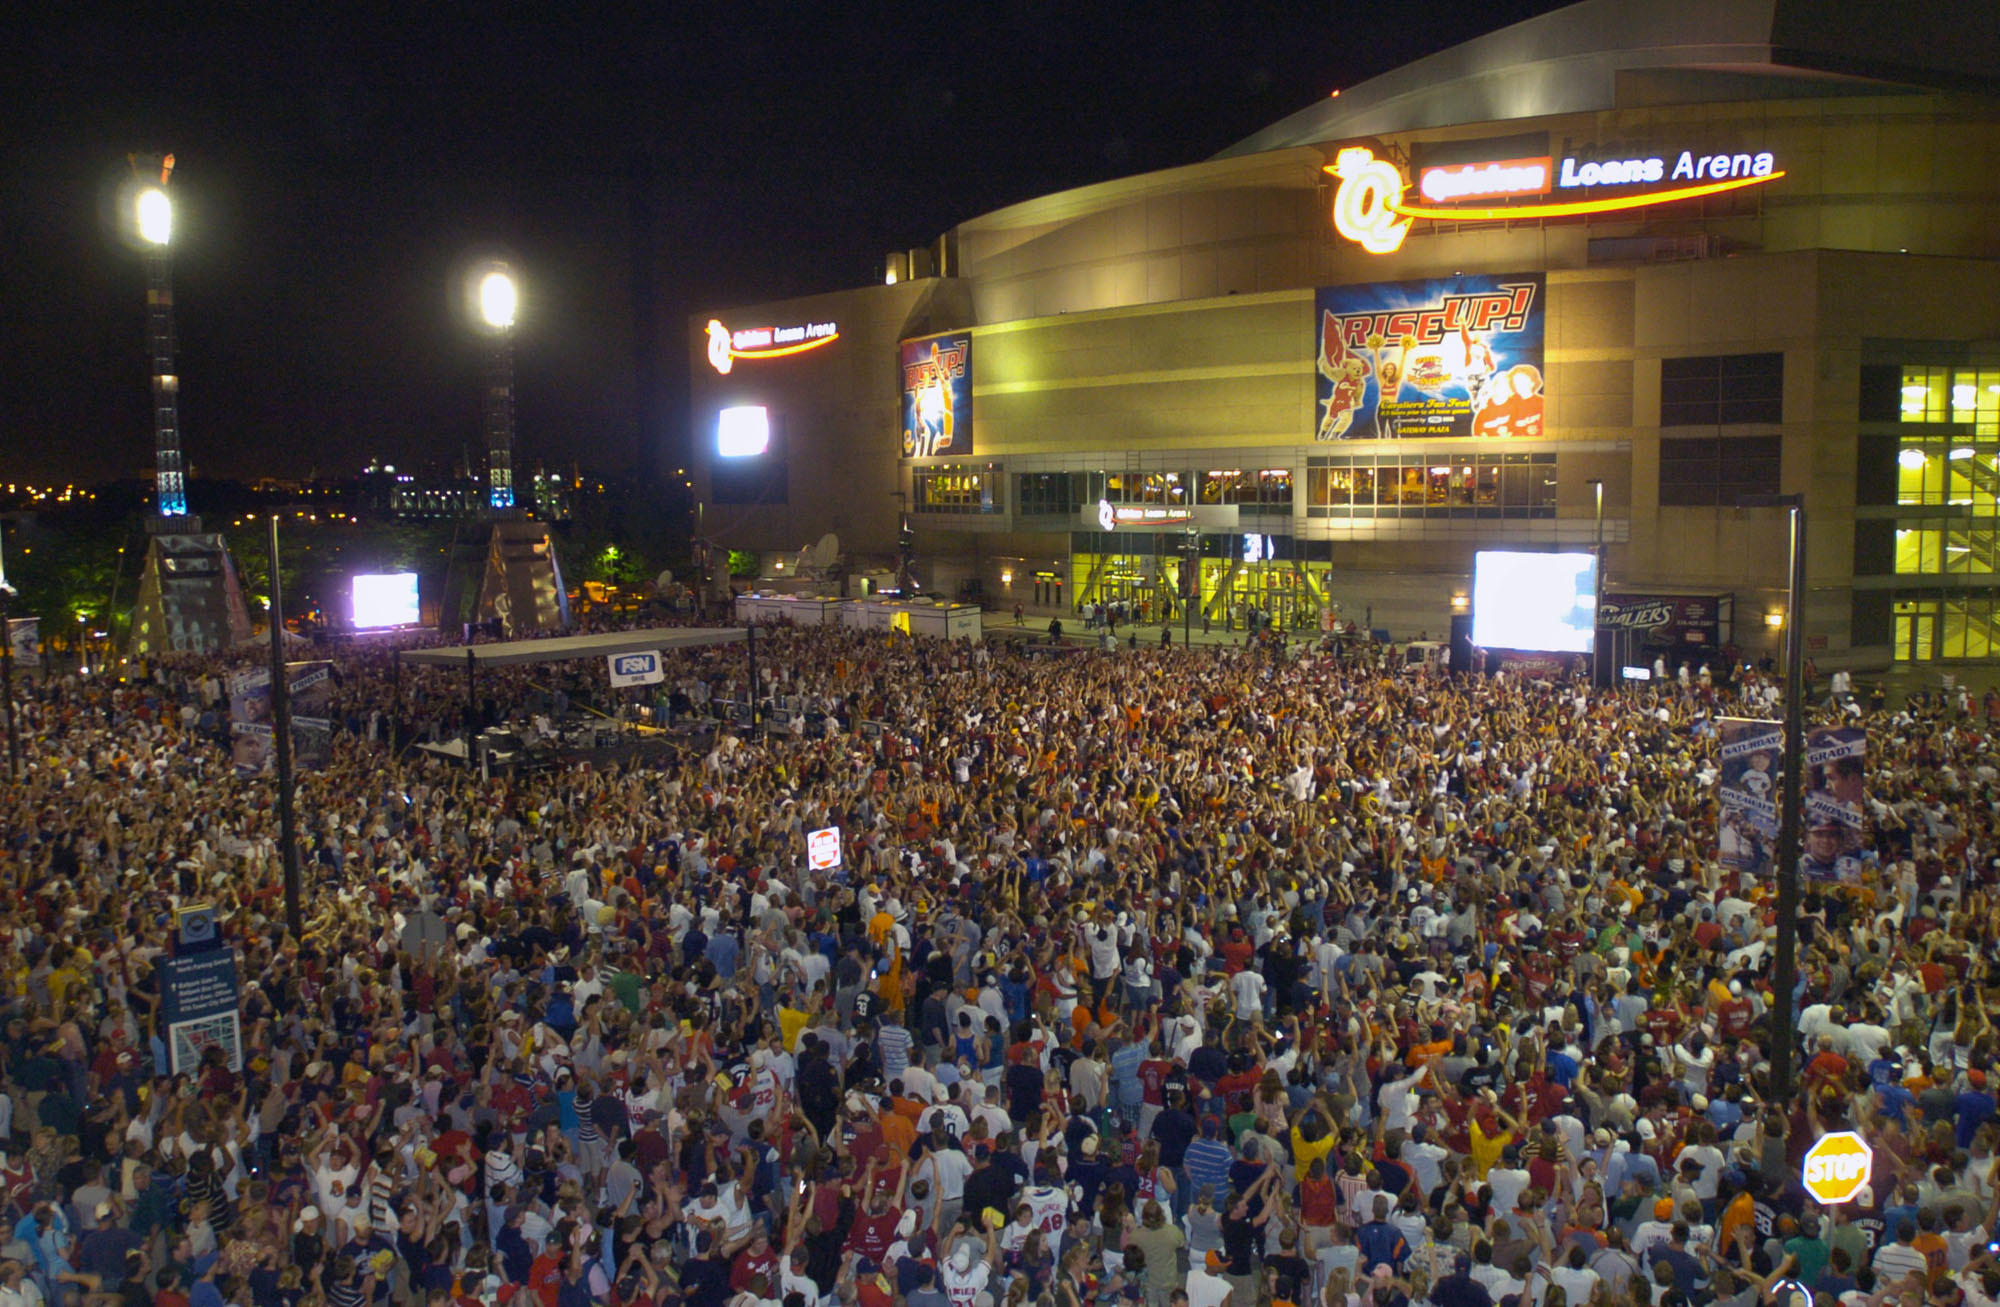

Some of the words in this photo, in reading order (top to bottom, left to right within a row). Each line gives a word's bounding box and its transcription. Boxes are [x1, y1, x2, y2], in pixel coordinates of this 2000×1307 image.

[1560, 158, 1664, 188] Loans
[1671, 151, 1774, 180] Arena
[1343, 312, 1445, 346] RISE
[1443, 287, 1532, 330] UP!
[621, 656, 650, 673] FSN
[1723, 735, 1777, 756] SATURDAY
[1809, 745, 1854, 764] GRADY
[1721, 790, 1774, 813] GIVEAWAYS
[1808, 1153, 1867, 1183] STOP
